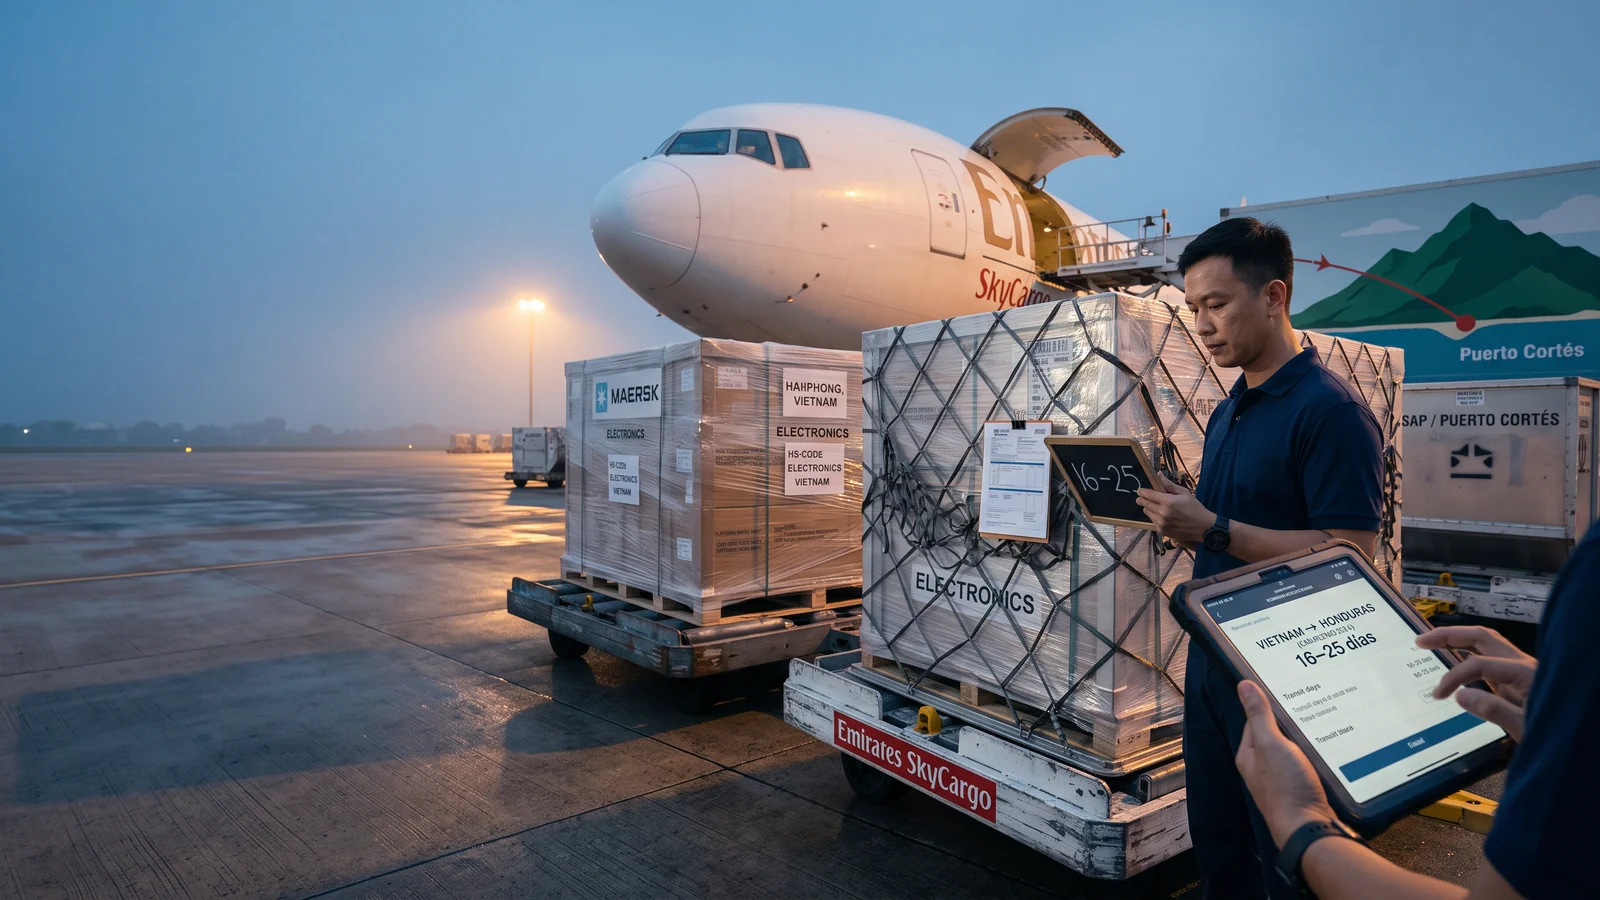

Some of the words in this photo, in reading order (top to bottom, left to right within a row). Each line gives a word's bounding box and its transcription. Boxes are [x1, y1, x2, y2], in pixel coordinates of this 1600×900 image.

[1460, 345, 1518, 361] Puerto
[1523, 342, 1584, 359] Cortés
[611, 384, 659, 404] MAERSK
[793, 396, 837, 407] VIETNAM
[1402, 415, 1427, 427] SAP
[1430, 414, 1436, 428] /
[1440, 413, 1495, 427] PUERTO
[1500, 410, 1560, 427] CORTÉS
[606, 429, 645, 439] ELECTRONICS
[776, 426, 849, 438] ELECTRONICS
[788, 450, 823, 458] HS-CODE
[788, 464, 842, 472] ELECTRONICS
[609, 474, 638, 483] ELECTRONICS
[795, 478, 830, 486] VIETNAM
[1071, 462, 1141, 493] 16-25
[916, 572, 1035, 615] ELECTRONICS
[1256, 627, 1306, 650] VIETNAM
[1318, 603, 1376, 629] HONDURAS
[1295, 640, 1346, 667] 16-25
[838, 718, 902, 768] Emirates
[907, 751, 992, 811] SkyCargo
